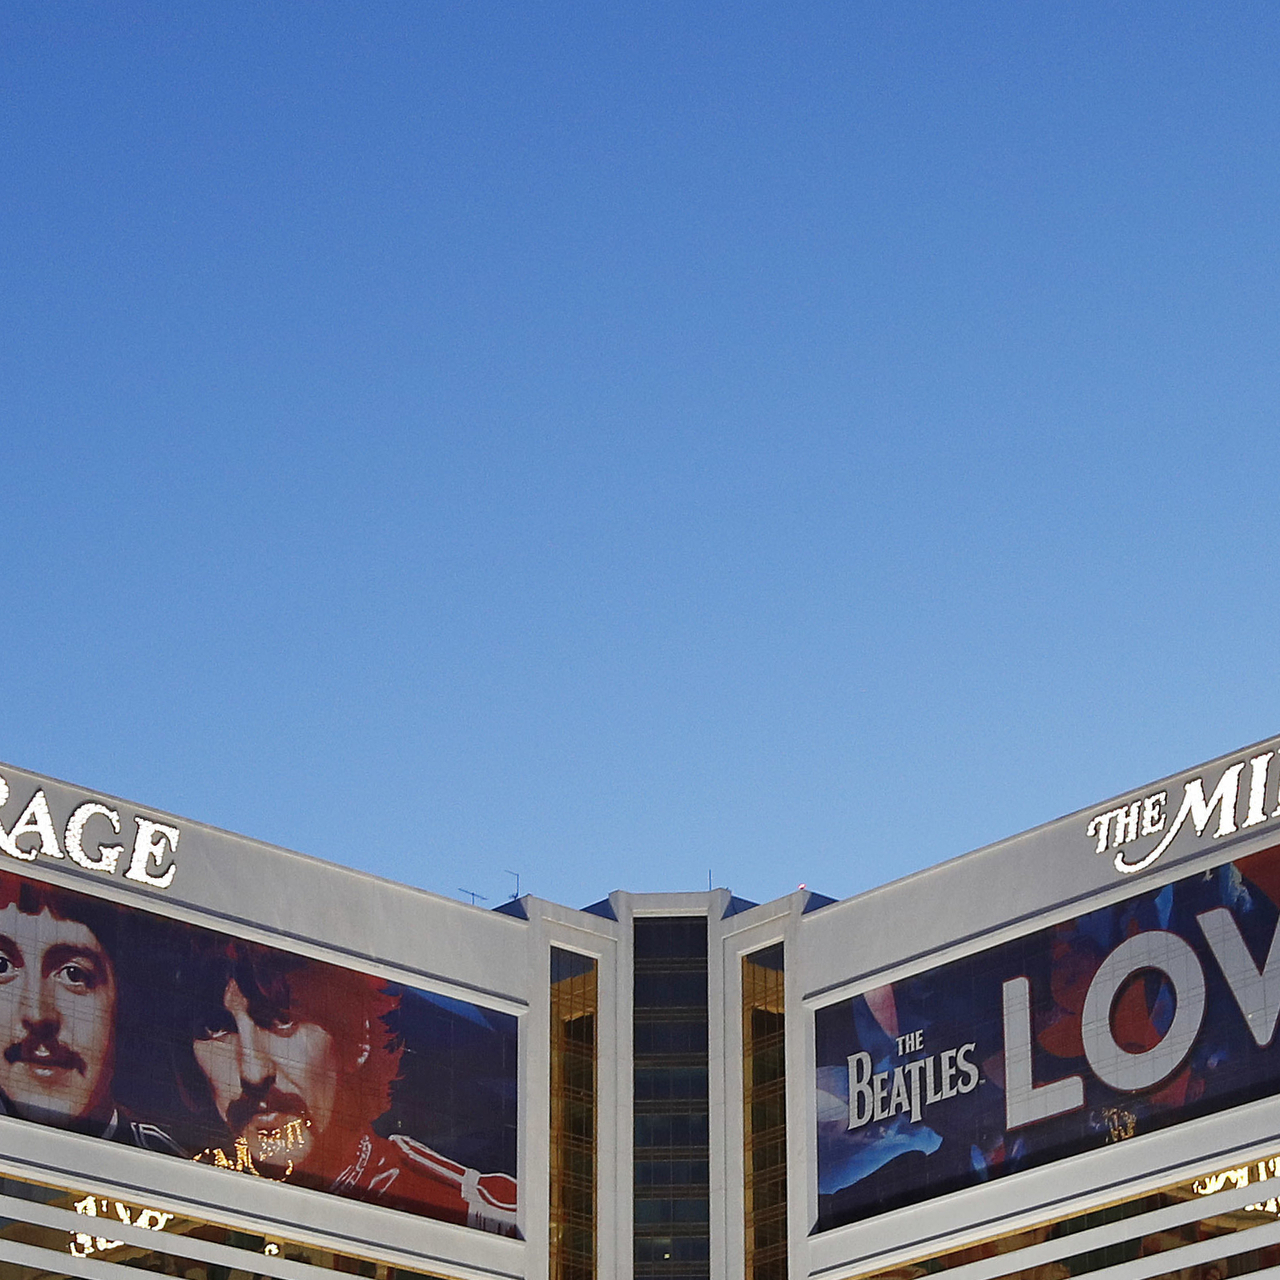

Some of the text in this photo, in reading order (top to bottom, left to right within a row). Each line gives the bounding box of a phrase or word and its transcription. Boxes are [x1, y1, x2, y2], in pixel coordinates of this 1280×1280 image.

[1086, 791, 1168, 854] THE
[895, 1029, 925, 1057] THE
[846, 1042, 980, 1131] BEATLES
